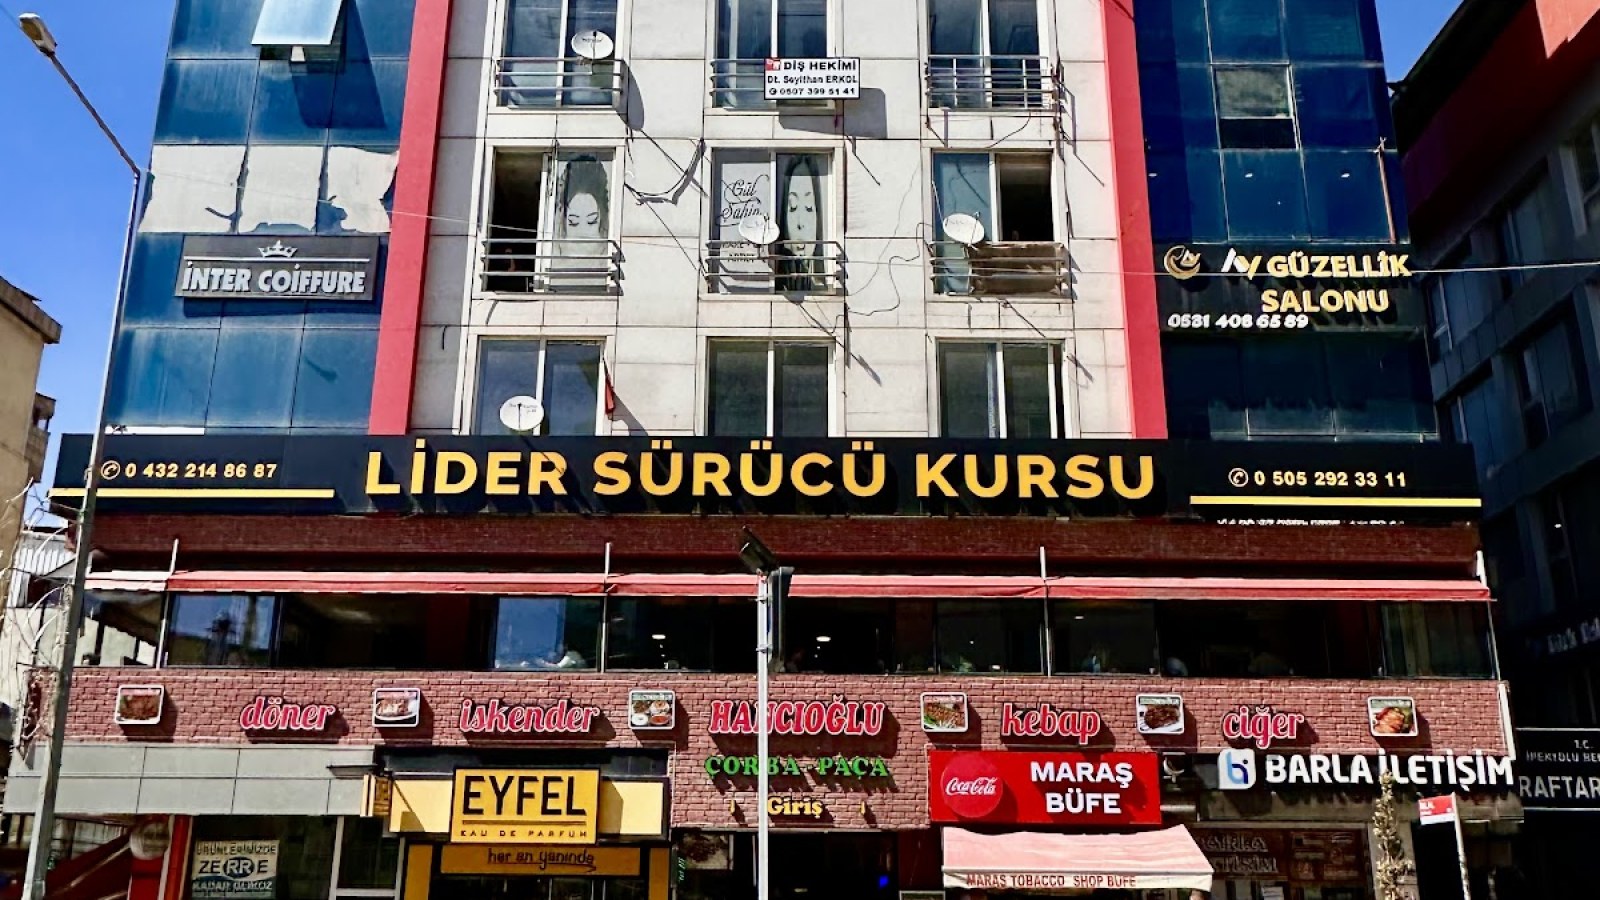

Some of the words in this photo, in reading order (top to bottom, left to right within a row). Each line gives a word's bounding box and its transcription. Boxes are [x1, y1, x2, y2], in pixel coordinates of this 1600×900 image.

[784, 60, 805, 72] DİŞ
[810, 60, 856, 71] HEKİMİ
[826, 75, 858, 84] ERKOL
[1267, 251, 1412, 278] GÜZELLİK
[182, 261, 251, 292] İNTER
[258, 264, 366, 294] COİFFURE
[1261, 289, 1389, 313] SALONU
[1168, 314, 1209, 328] 0531
[1215, 314, 1253, 328] 408
[1256, 314, 1281, 328] 65
[1284, 314, 1308, 328] 89
[125, 463, 137, 477] 0
[143, 463, 178, 478] 432
[184, 463, 217, 478] 214
[223, 463, 247, 478] 86
[253, 464, 278, 478] 87
[365, 438, 568, 496] LİDER
[593, 439, 886, 497] SÜRÜCÜ
[916, 452, 1154, 500] KURSU
[1254, 471, 1265, 486] 0
[1272, 471, 1307, 486] 505
[1314, 471, 1348, 486] 292
[1355, 472, 1377, 487] 33
[1385, 472, 1406, 487] 11
[240, 696, 335, 731] döner
[460, 699, 600, 732] iskender
[1001, 703, 1100, 745] kebap
[1223, 706, 1304, 749] ciğer
[704, 755, 800, 779] ÇORBA
[818, 755, 889, 780] PAÇA
[1030, 761, 1133, 789] MARAŞ
[1265, 754, 1373, 785] BARLA
[1378, 748, 1514, 792] İLETİŞİM
[462, 776, 587, 816] EYFEL
[767, 797, 823, 819] Giriş
[1045, 788, 1121, 814] BÜFE
[528, 830, 587, 838] PARFUM
[199, 858, 269, 876] ZERRE
[487, 848, 511, 864] her
[516, 851, 533, 864] an
[1011, 874, 1065, 887] TOBACCO
[1073, 875, 1103, 888] SHOP
